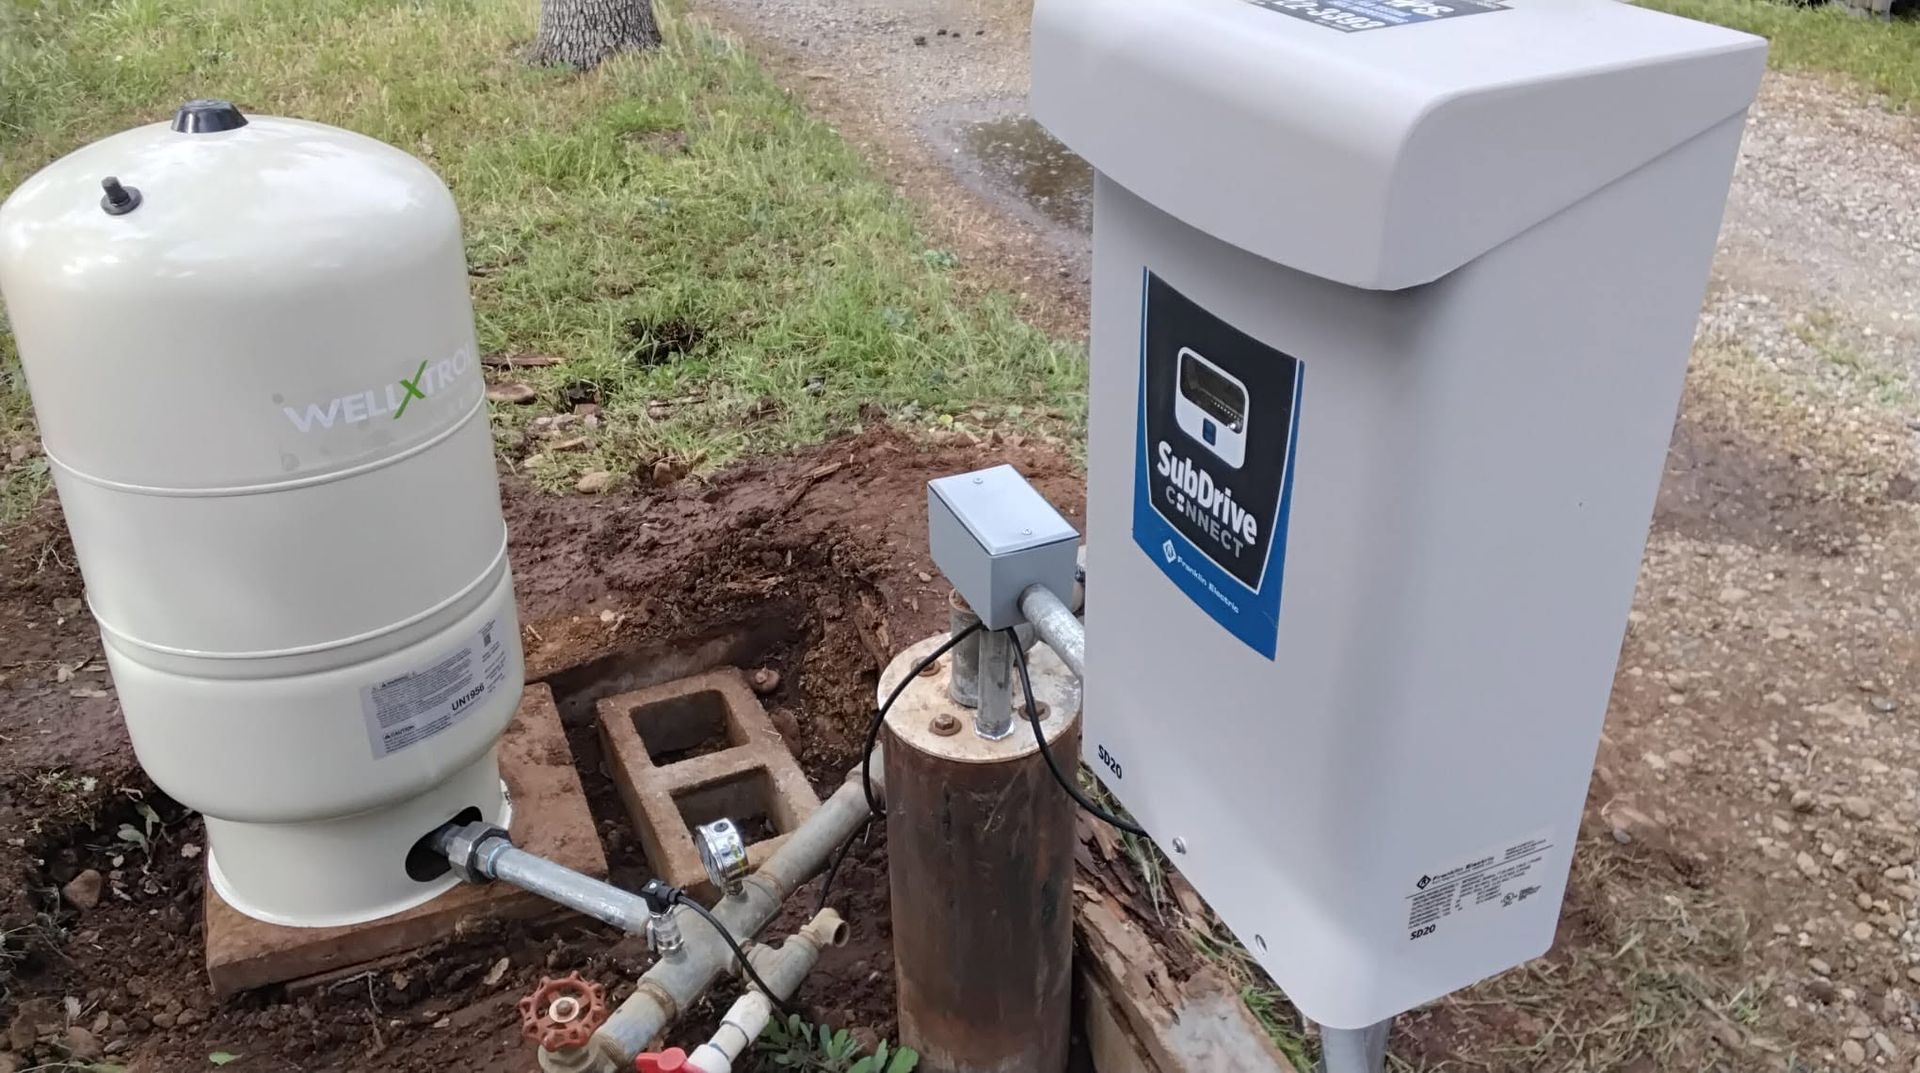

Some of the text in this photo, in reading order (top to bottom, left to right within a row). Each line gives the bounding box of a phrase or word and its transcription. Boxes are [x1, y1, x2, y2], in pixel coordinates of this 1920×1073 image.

[1156, 440, 1258, 546] SubDrive
[1165, 485, 1244, 559] CONNECT
[1177, 555, 1240, 614] Franklin Electric
[451, 682, 485, 711] UN1956
[1098, 744, 1122, 780] SD20
[1409, 923, 1437, 941] SD20
